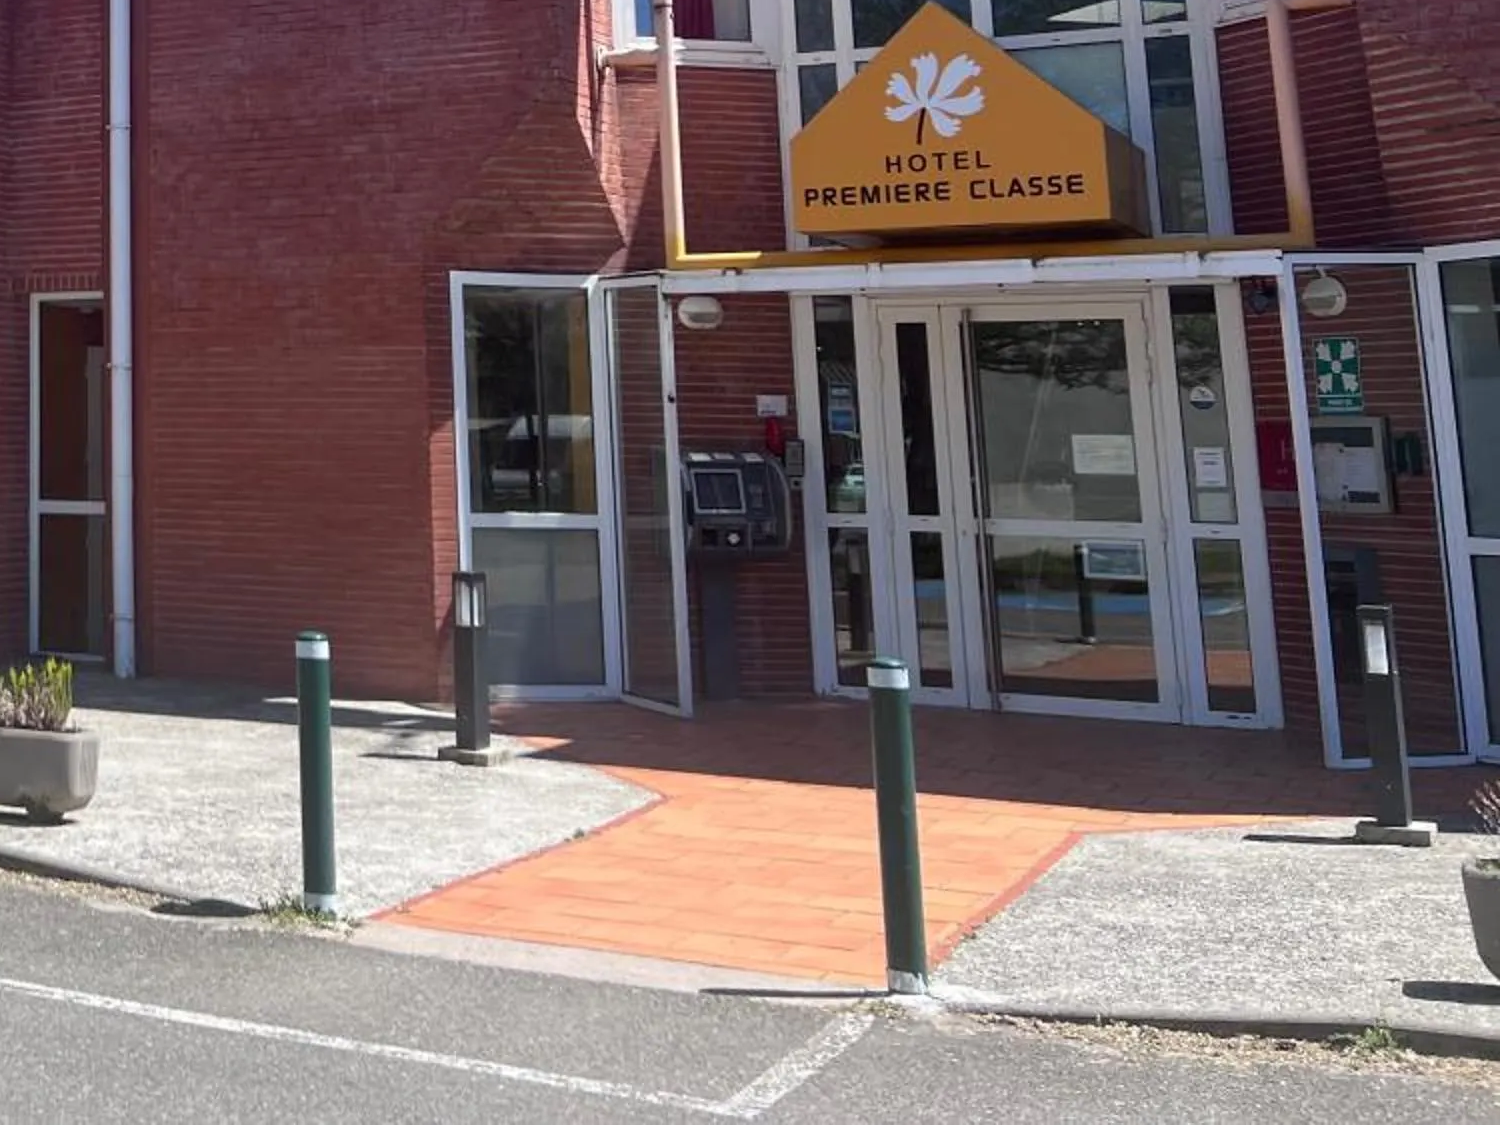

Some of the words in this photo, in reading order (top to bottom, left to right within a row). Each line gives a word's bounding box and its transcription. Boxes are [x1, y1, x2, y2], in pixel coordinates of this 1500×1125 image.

[885, 150, 991, 173] HOTEL
[804, 181, 951, 207] PREMIERE
[969, 174, 1084, 200] CLASSE
